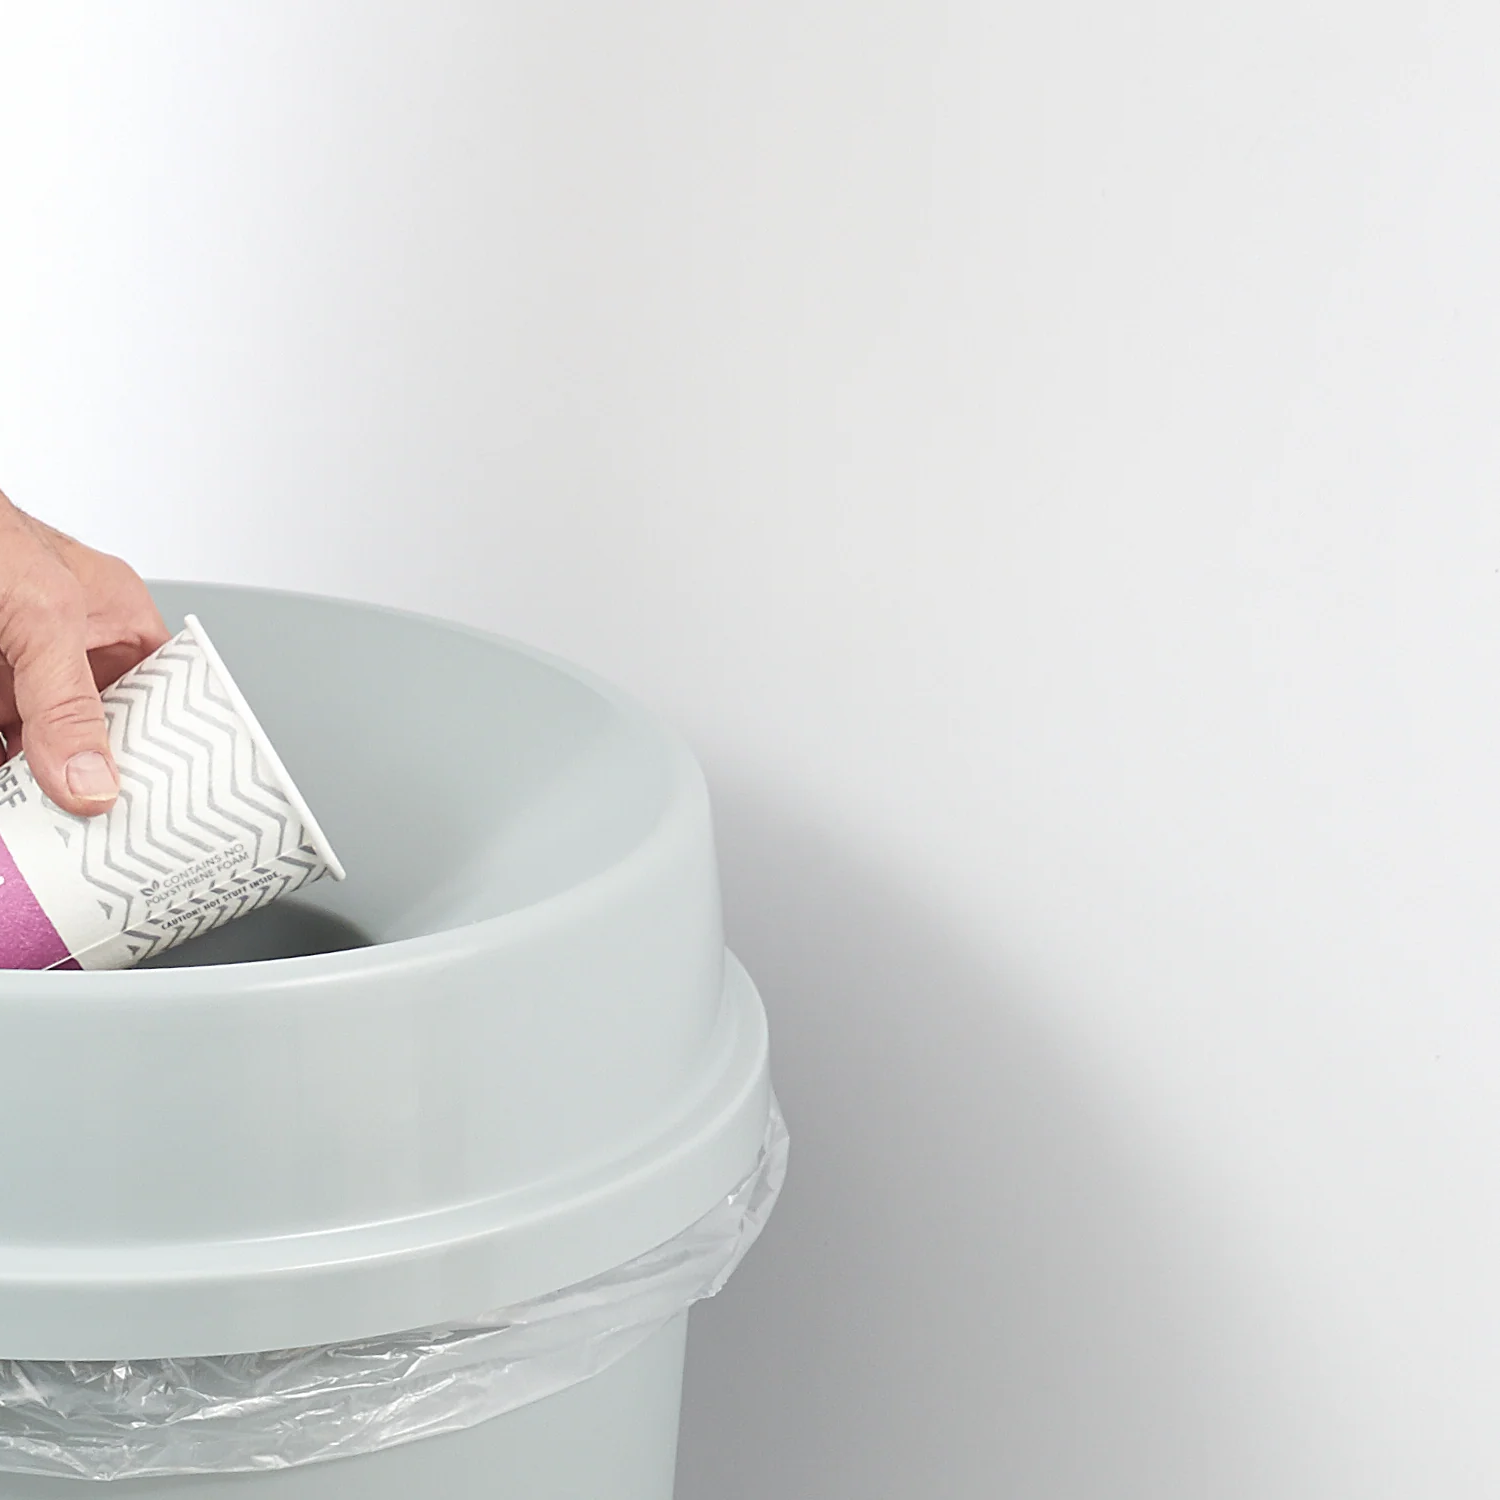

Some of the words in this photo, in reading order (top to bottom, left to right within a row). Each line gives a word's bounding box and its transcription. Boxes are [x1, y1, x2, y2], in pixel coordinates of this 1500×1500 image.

[145, 869, 216, 907] POLYSTYRENE
[217, 852, 249, 872] FOAM
[163, 854, 221, 888] CONTAINS
[224, 843, 244, 858] NO
[161, 907, 202, 930] CAUTION!
[223, 885, 247, 902] STUFF
